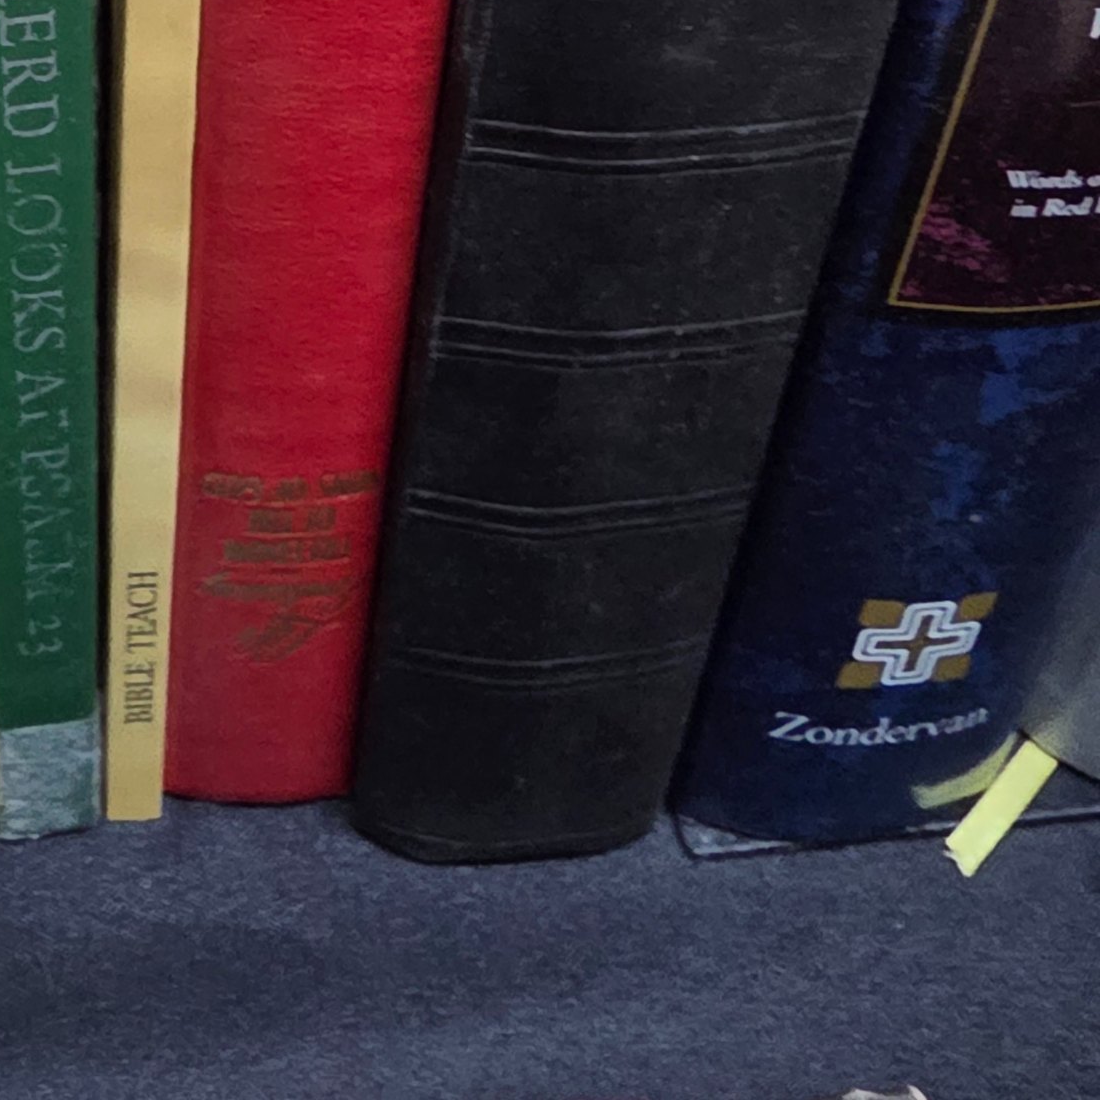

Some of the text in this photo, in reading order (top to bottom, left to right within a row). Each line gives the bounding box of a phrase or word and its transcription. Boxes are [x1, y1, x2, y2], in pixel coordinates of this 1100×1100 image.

[4, 152, 69, 353] LOOKS
[15, 370, 70, 429] AT
[18, 614, 63, 656] 23
[124, 571, 159, 725] BIBLE TEACH
[768, 707, 992, 746] Zondervan
